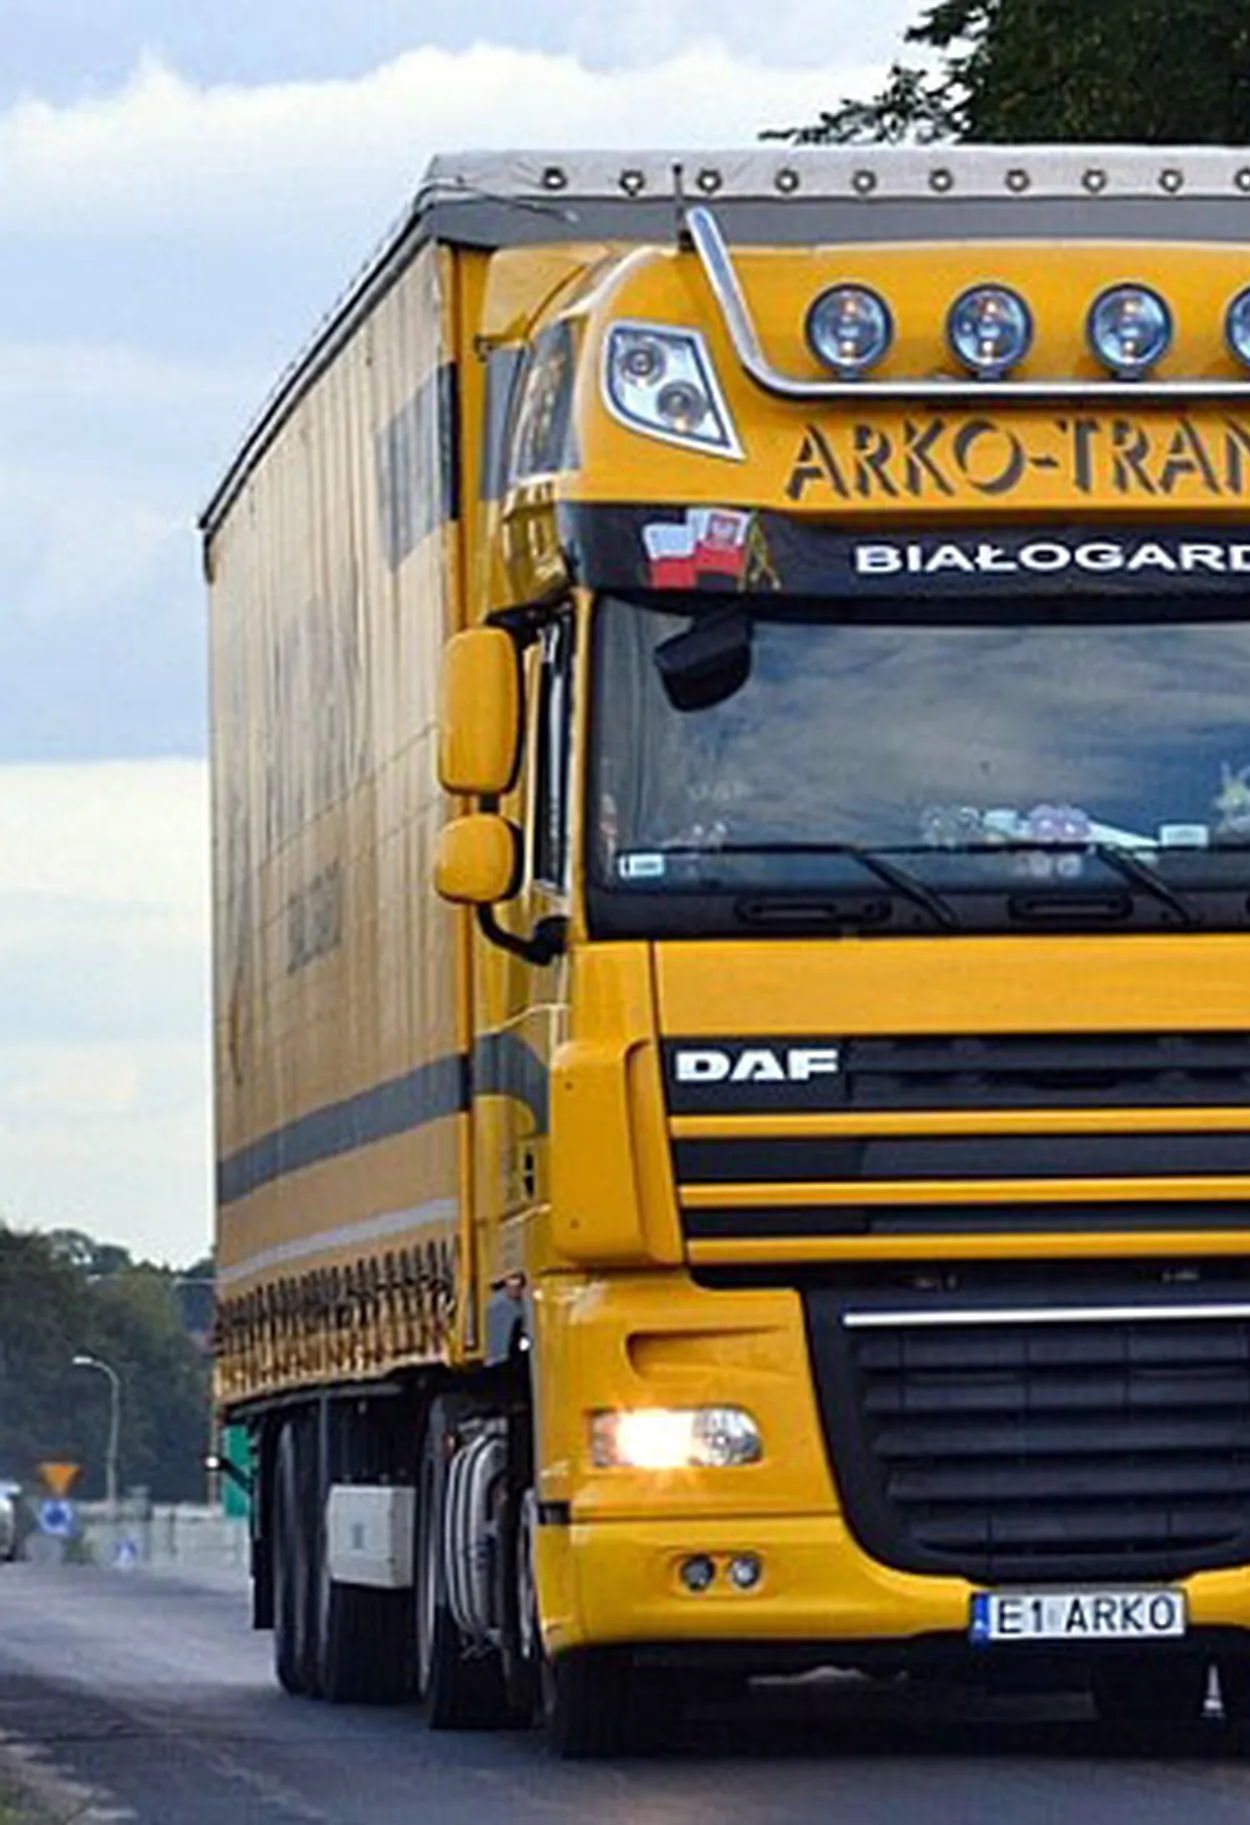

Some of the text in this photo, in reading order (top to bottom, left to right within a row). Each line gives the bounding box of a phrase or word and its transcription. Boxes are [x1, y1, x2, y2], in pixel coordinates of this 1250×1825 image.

[675, 1049, 839, 1082] DAF
[999, 1595, 1176, 1634] E1 ARKO
